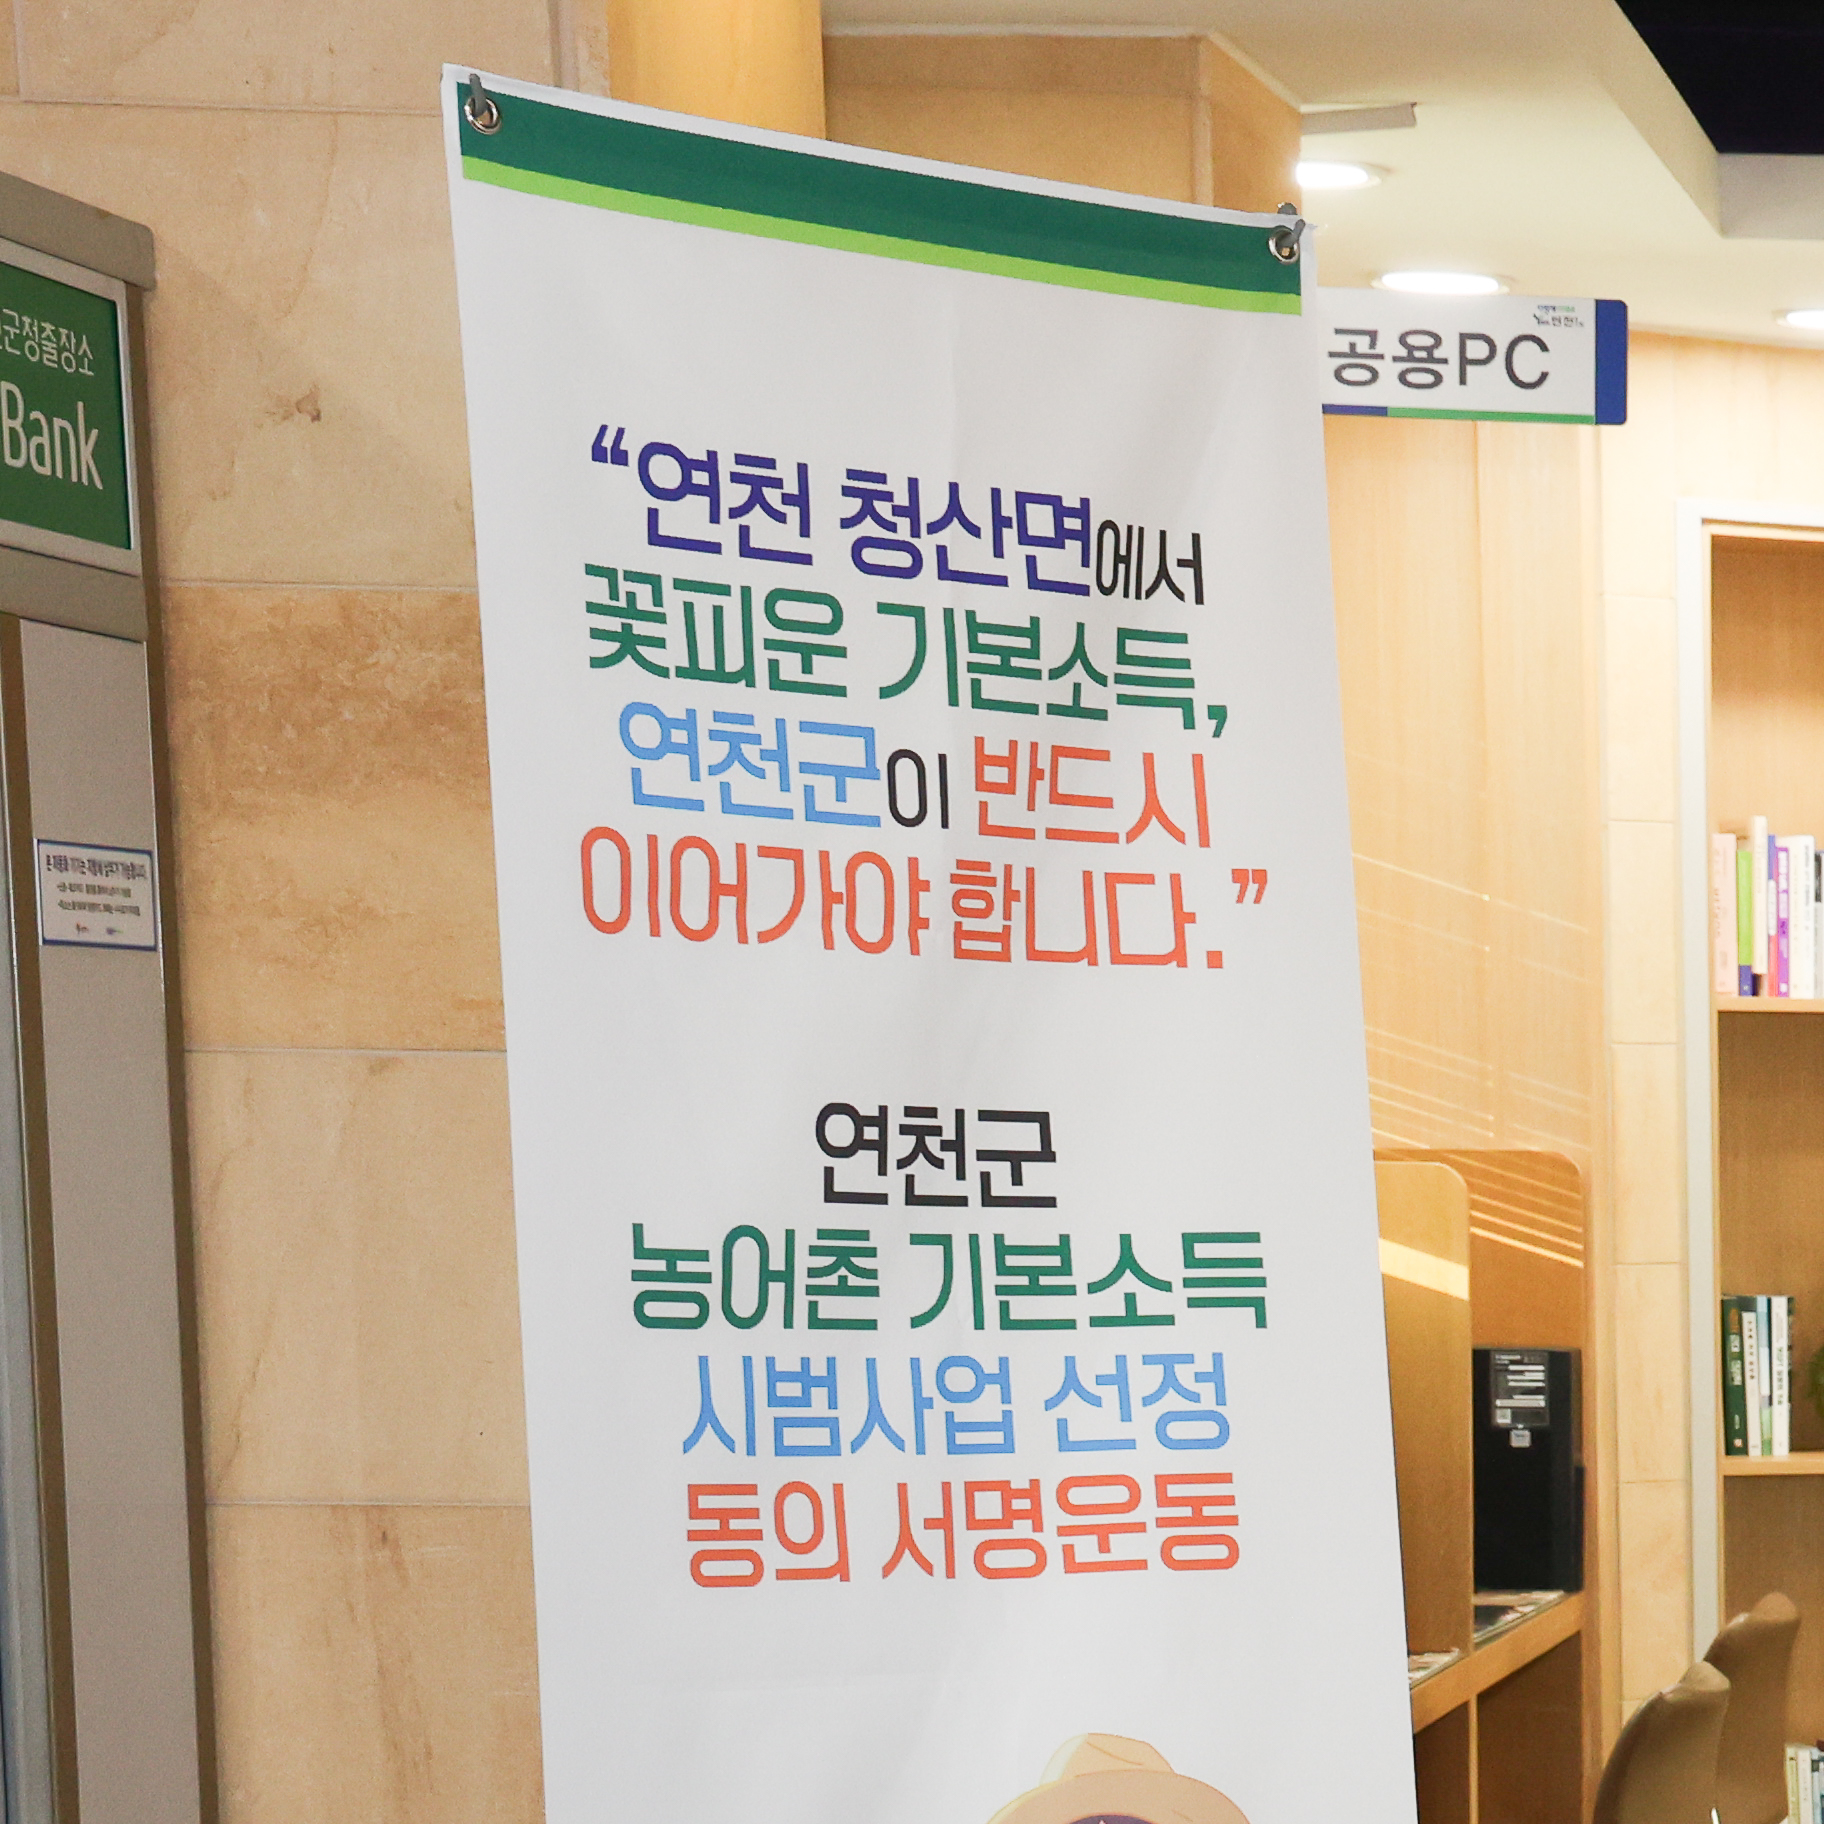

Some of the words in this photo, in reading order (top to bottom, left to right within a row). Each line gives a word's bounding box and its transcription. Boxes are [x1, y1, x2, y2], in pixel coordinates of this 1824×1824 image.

[0, 309, 94, 376] 군청출장소
[1328, 328, 1550, 389] 공용PC
[0, 381, 103, 490] Bank
[841, 468, 1203, 604] 청산면에서
[585, 564, 847, 698] 꽃피운
[878, 602, 1227, 737] 기본소득,
[620, 702, 948, 828] 연천군이
[974, 737, 1210, 848] 반드시
[581, 827, 929, 955] 이어가야
[816, 1103, 1057, 1207] 연천군
[631, 1224, 880, 1330] 농어촌
[910, 1232, 1266, 1330] 기본소득
[683, 1355, 1015, 1456] 시범사업
[1045, 1352, 1229, 1452] 선정
[687, 1481, 850, 1587] 동의
[882, 1473, 1239, 1579] 서명운동
